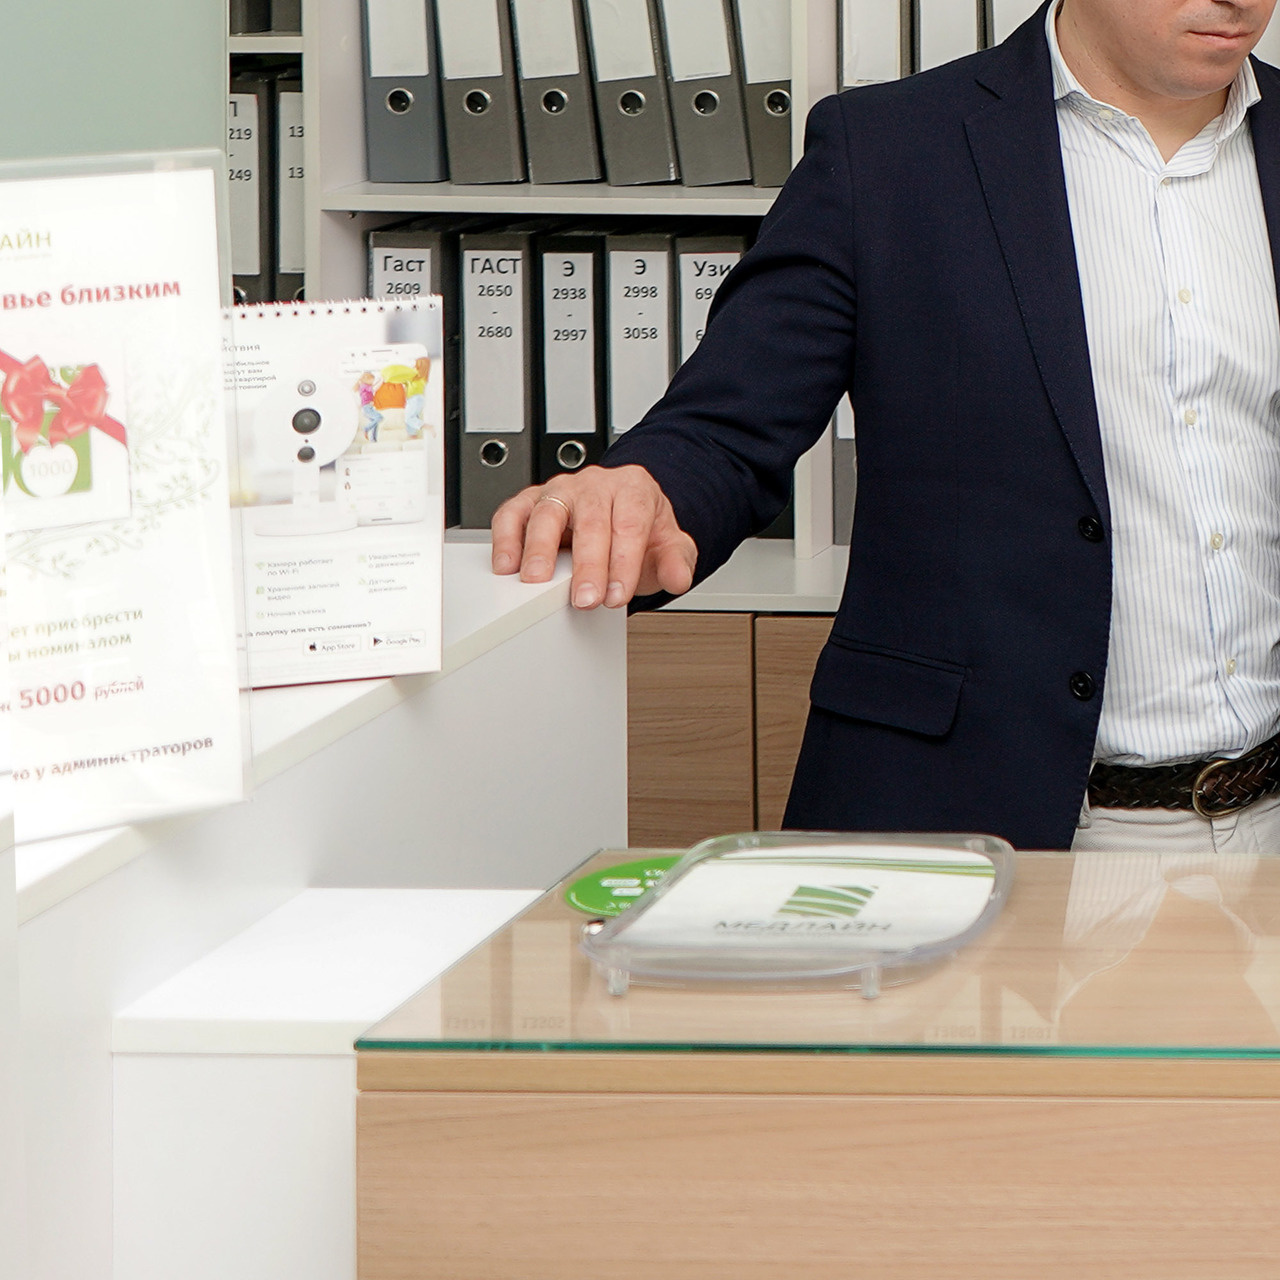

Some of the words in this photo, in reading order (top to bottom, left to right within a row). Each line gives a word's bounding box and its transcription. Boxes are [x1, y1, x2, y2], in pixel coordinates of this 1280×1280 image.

[384, 256, 425, 272] Гаст
[471, 258, 521, 274] ГАСТ
[563, 261, 574, 276] Э
[635, 259, 646, 275] Э
[60, 280, 182, 305] близким
[387, 283, 420, 294] 2609
[478, 285, 512, 296] 2650
[553, 288, 586, 299] 2938
[624, 286, 657, 298] 2998
[478, 326, 512, 337] 2680
[554, 329, 587, 341] 2997
[624, 327, 657, 339] 3058
[28, 460, 74, 478] 1000
[19, 679, 86, 710] 5000
